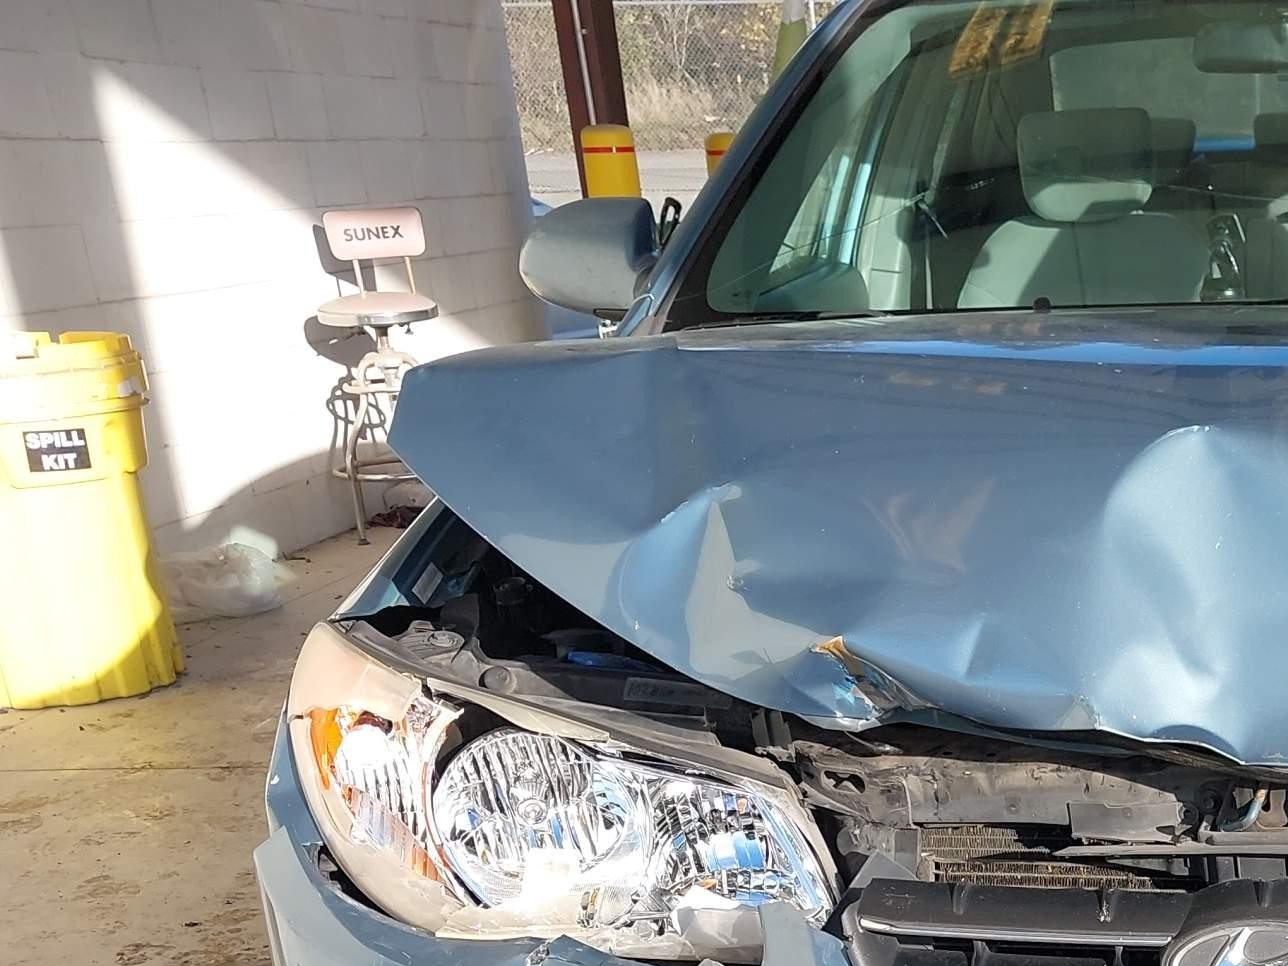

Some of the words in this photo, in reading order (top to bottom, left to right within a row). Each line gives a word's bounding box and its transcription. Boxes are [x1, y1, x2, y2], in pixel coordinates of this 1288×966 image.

[343, 225, 404, 242] SUNEX
[25, 430, 86, 450] SPILL
[41, 452, 77, 471] KIT
